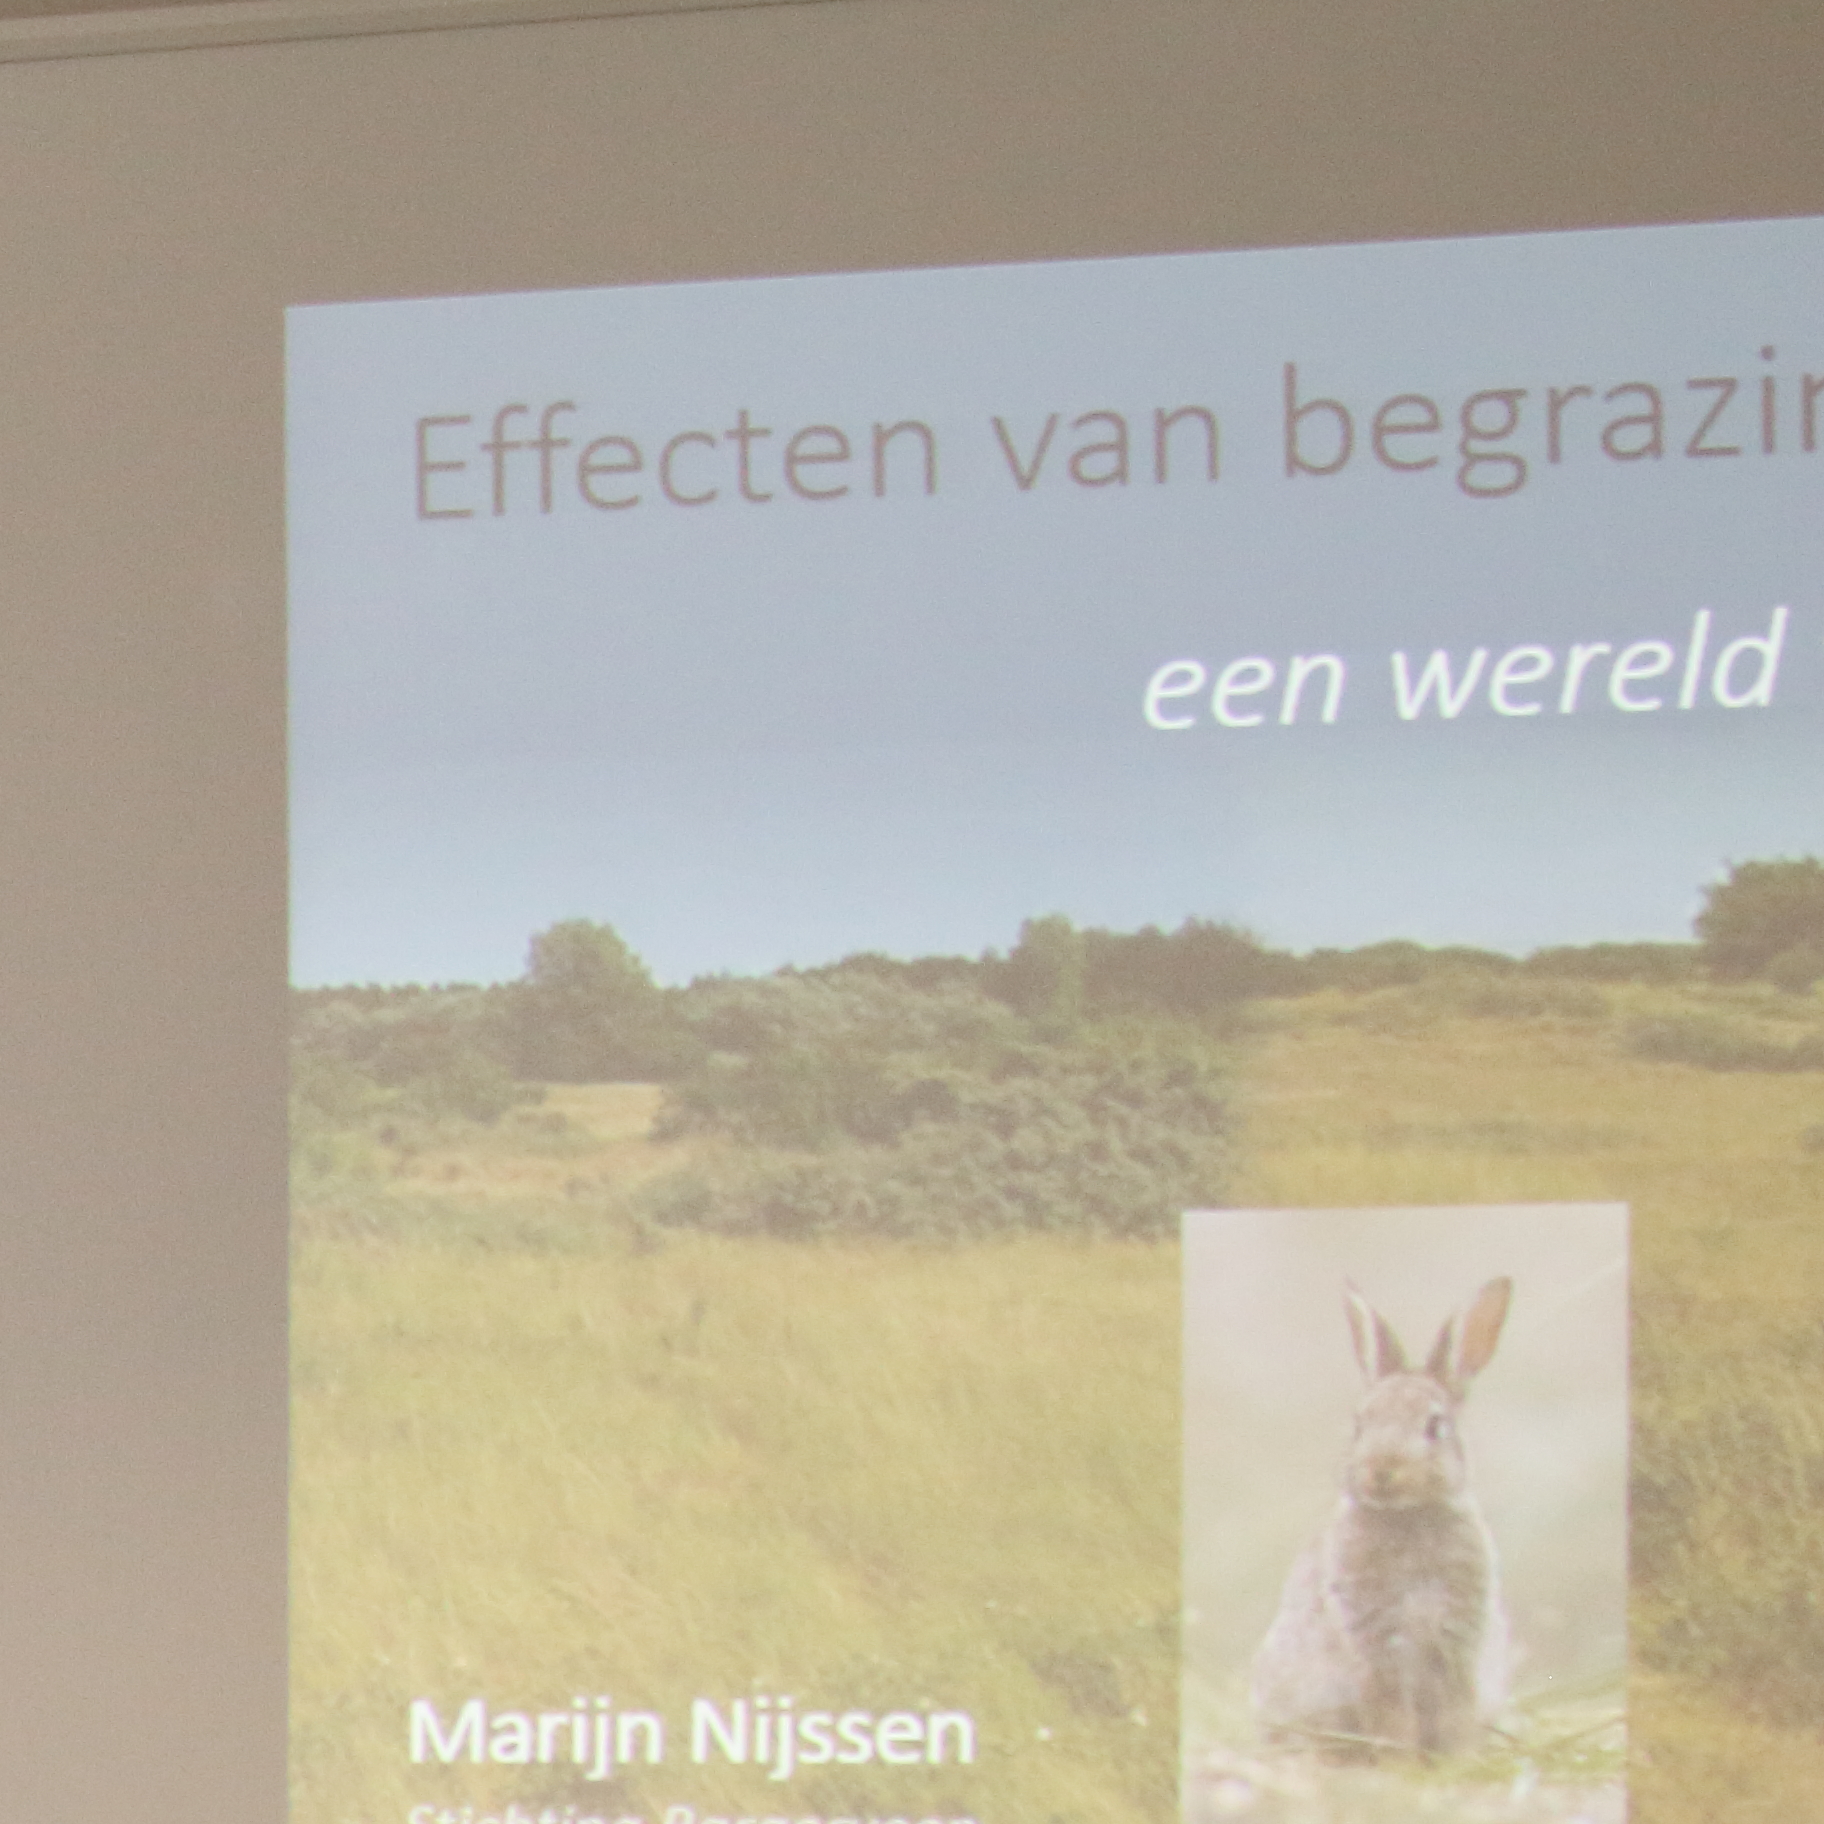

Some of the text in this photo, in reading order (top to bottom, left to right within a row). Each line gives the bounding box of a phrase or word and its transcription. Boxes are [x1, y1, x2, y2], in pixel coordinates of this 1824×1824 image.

[413, 400, 939, 524] Effecten
[991, 400, 1222, 494] van
[1142, 606, 1789, 731] een wereld
[408, 1696, 976, 1782] Marijn Nijssen
